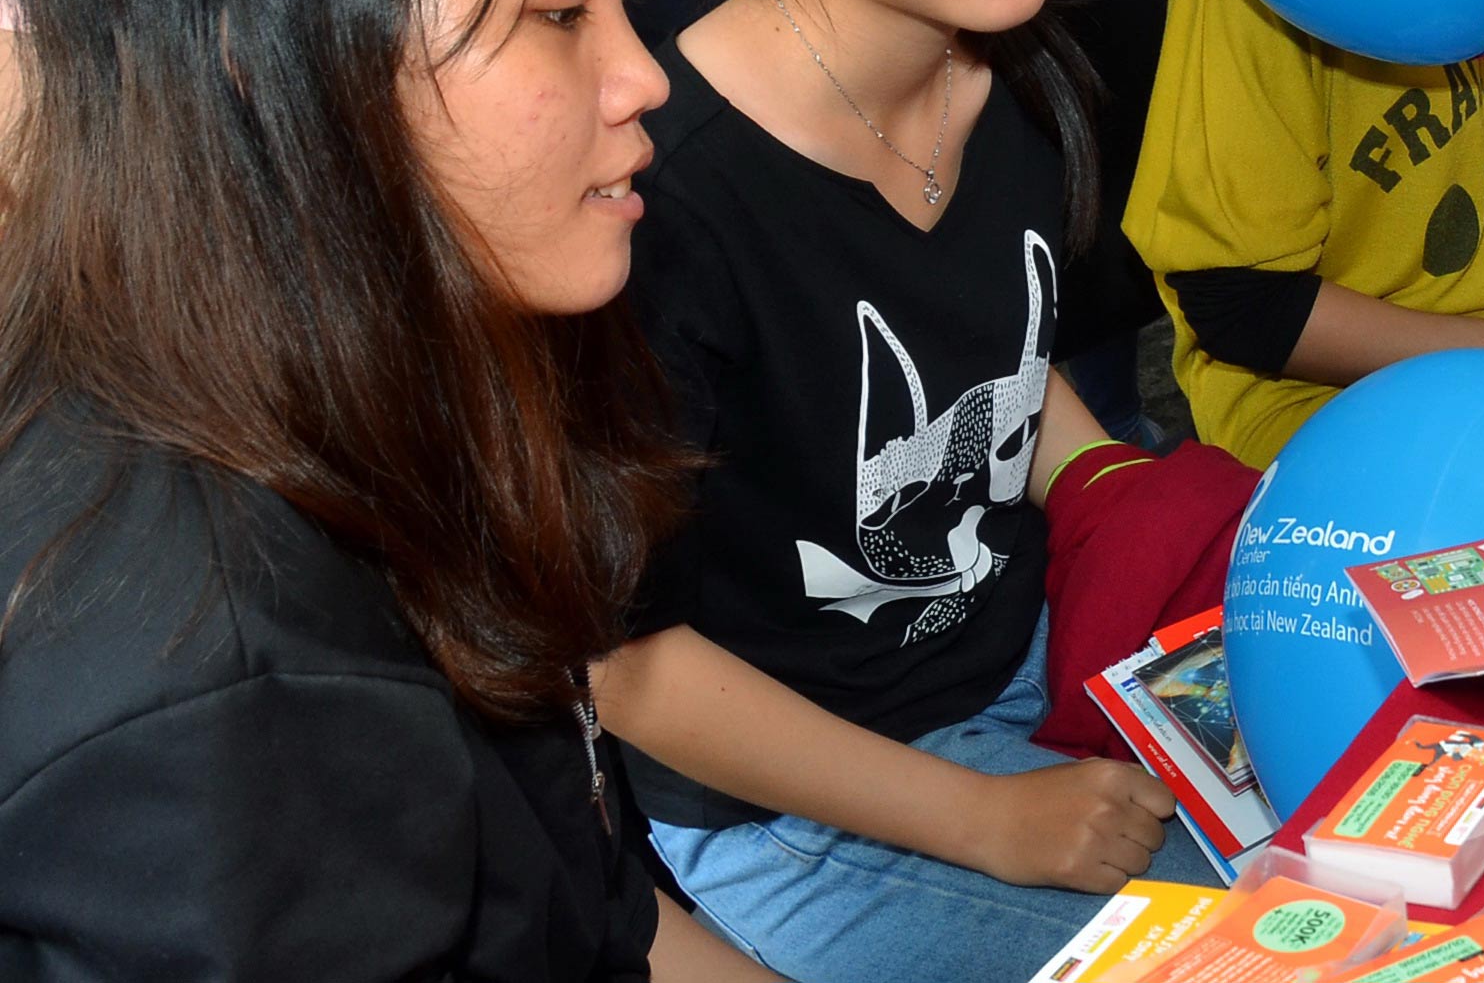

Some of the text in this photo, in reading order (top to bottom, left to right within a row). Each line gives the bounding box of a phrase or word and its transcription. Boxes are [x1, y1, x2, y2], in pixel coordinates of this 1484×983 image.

[1272, 517, 1396, 556] Zealand
[1236, 549, 1271, 567] Center
[1258, 572, 1280, 595] cản
[1283, 573, 1323, 607] tiếng
[1250, 610, 1265, 636] tại
[1267, 610, 1298, 634] New
[1301, 613, 1373, 647] Zealand
[1295, 908, 1332, 946] 500K
